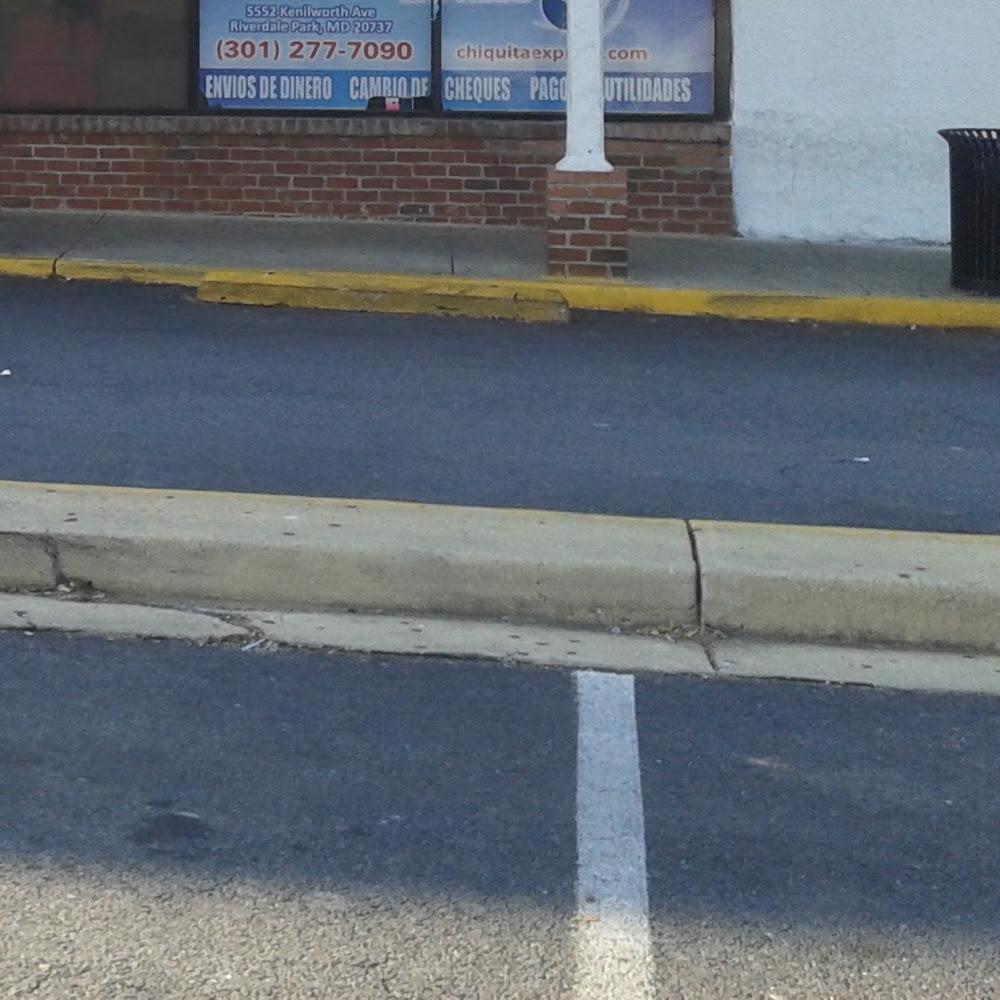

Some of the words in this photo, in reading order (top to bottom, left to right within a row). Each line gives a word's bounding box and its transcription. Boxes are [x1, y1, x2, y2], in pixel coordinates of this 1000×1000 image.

[245, 5, 277, 18] 5552
[280, 4, 350, 18] Kenilworth
[351, 5, 377, 18] Ave
[229, 20, 288, 33] Riverdale
[291, 21, 324, 35] Park,
[326, 21, 350, 33] MD
[354, 21, 393, 33] 20737
[216, 39, 280, 61] (301)
[289, 40, 413, 61] 277-7090
[205, 74, 256, 99] ENVIOS
[259, 75, 277, 99] DE
[280, 75, 332, 100] DINERO
[349, 75, 407, 100] CAMBIO
[410, 76, 429, 98] DE
[444, 75, 511, 103] CHEQUES
[603, 77, 692, 103] UTILIDADES
